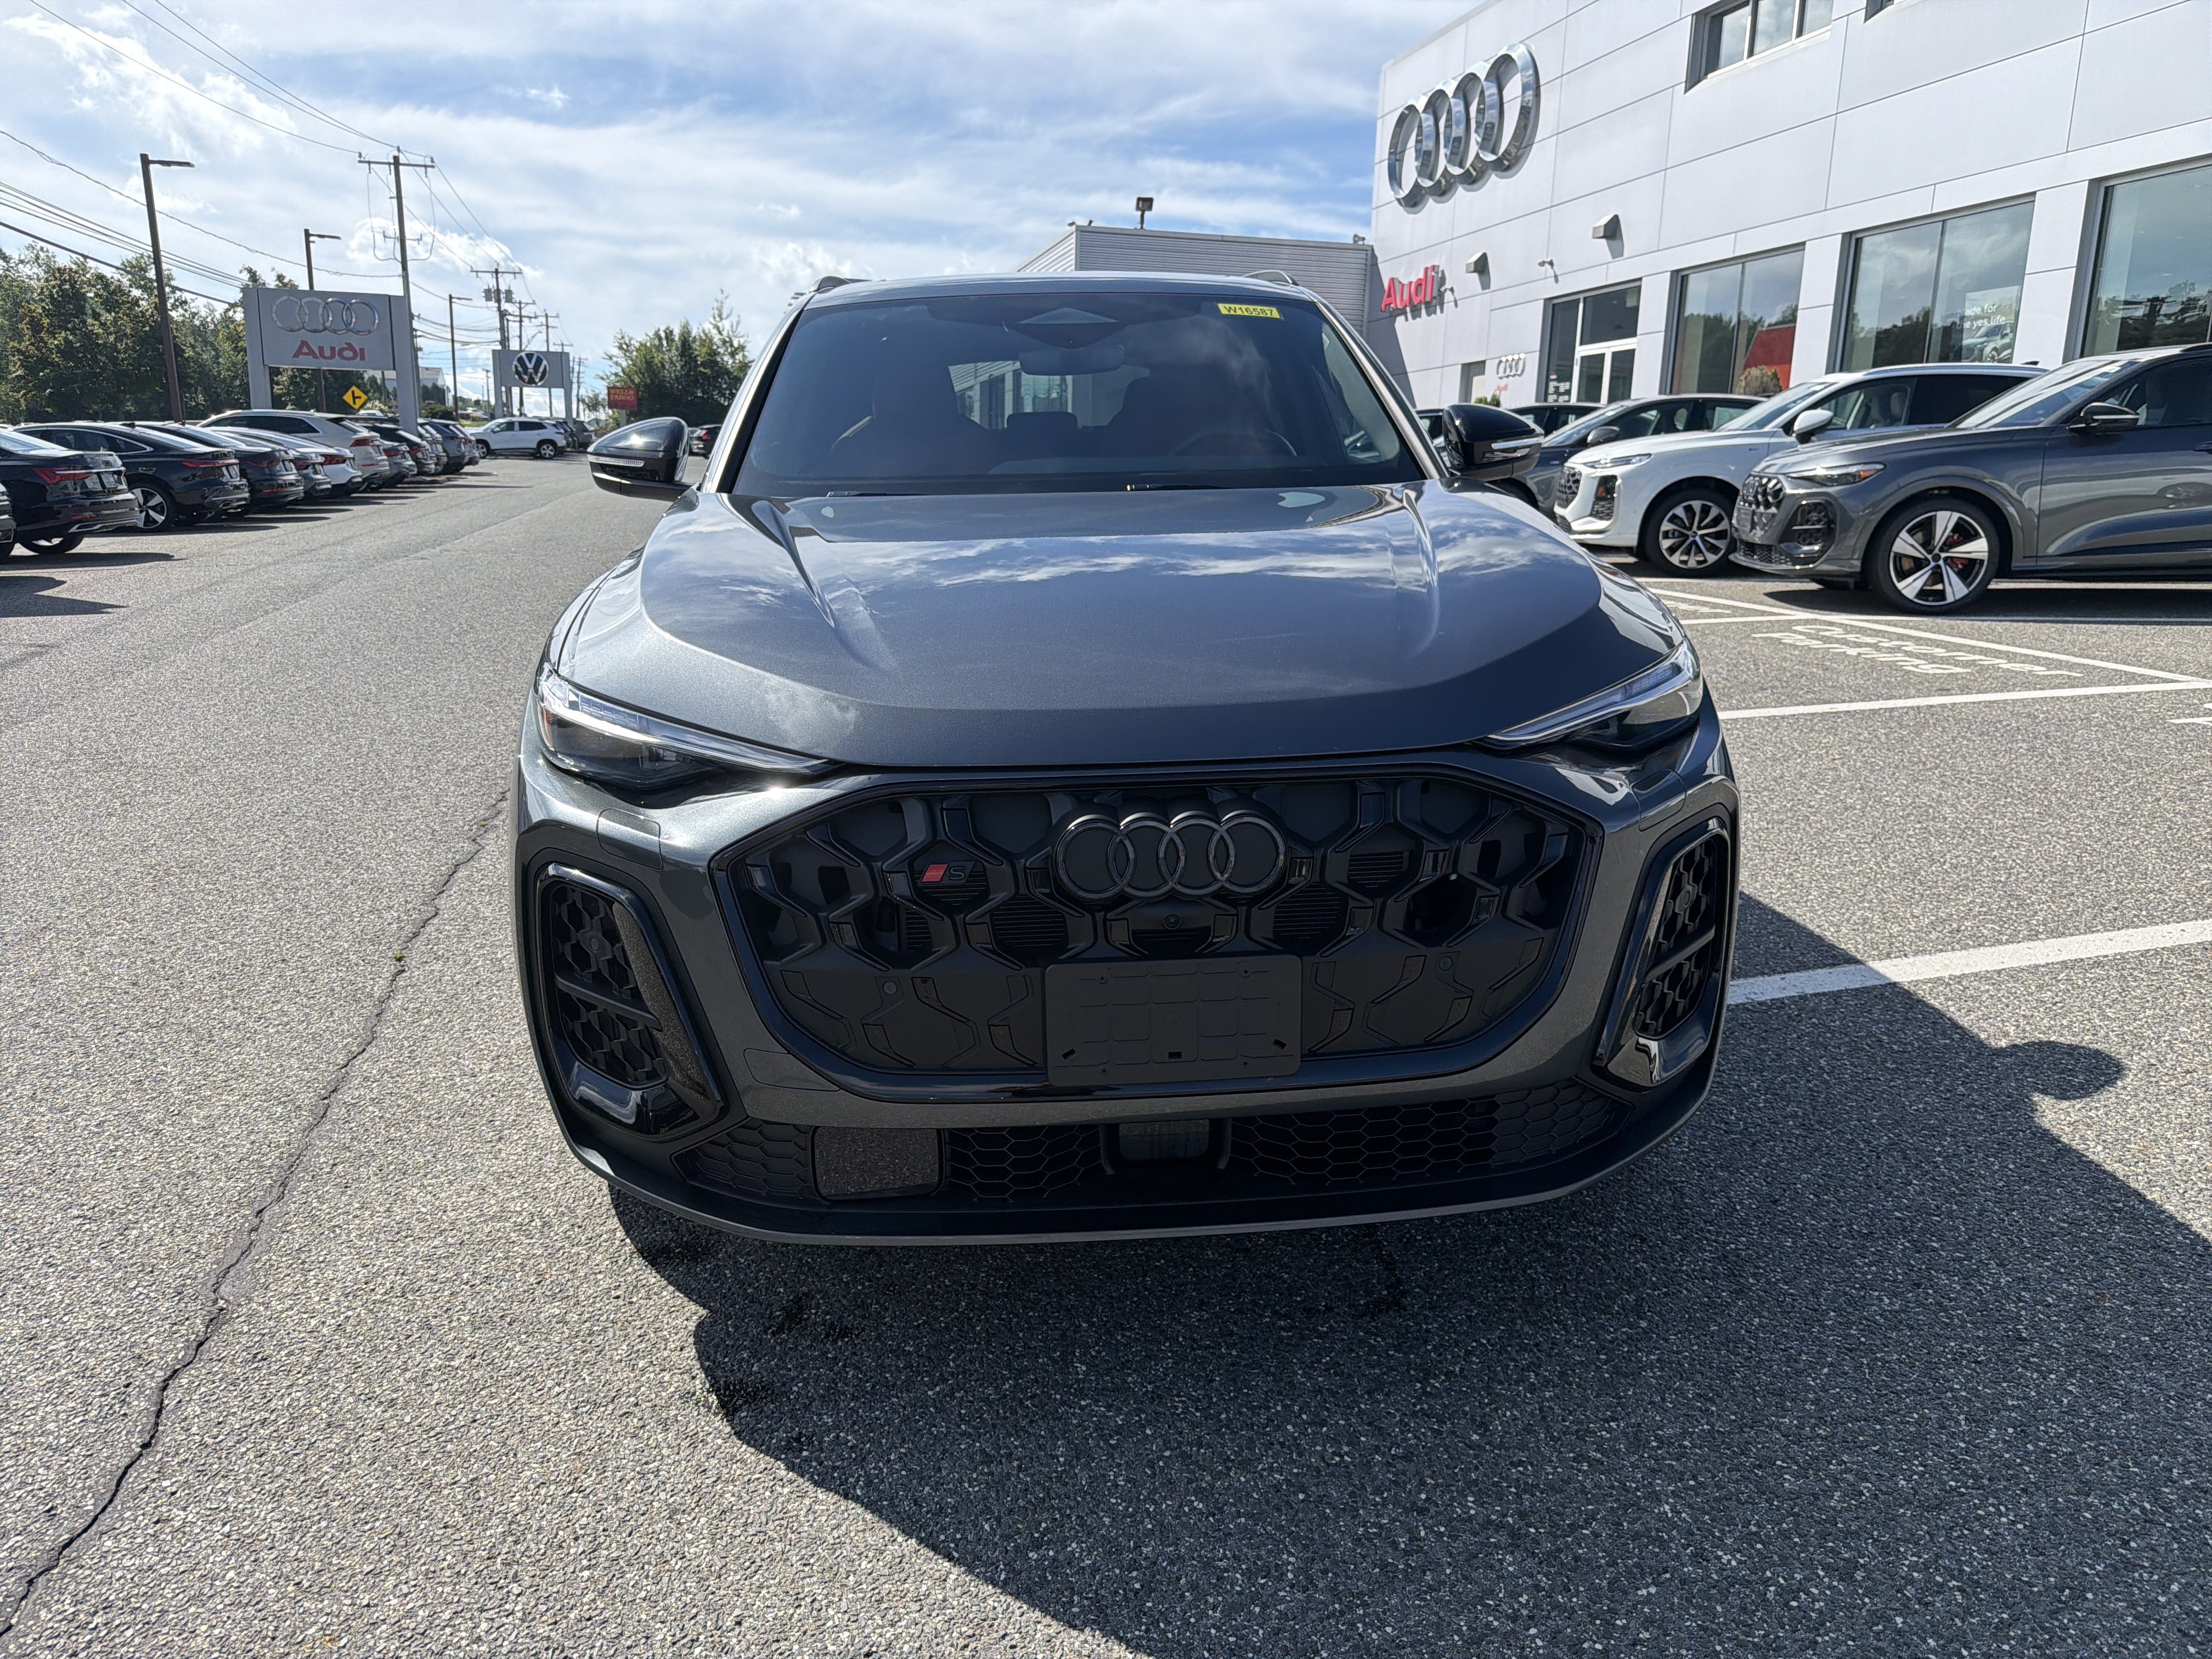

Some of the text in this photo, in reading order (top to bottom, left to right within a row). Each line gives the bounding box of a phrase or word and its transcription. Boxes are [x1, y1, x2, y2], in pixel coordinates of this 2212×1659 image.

[1381, 264, 1435, 313] Audi
[1223, 306, 1273, 316] W16587
[1984, 303, 1997, 313] for
[1972, 318, 1988, 329] yes
[1990, 314, 2006, 325] life
[292, 340, 365, 362] Audi
[1751, 632, 1973, 674] Parking
[1792, 625, 2084, 676] Customer
